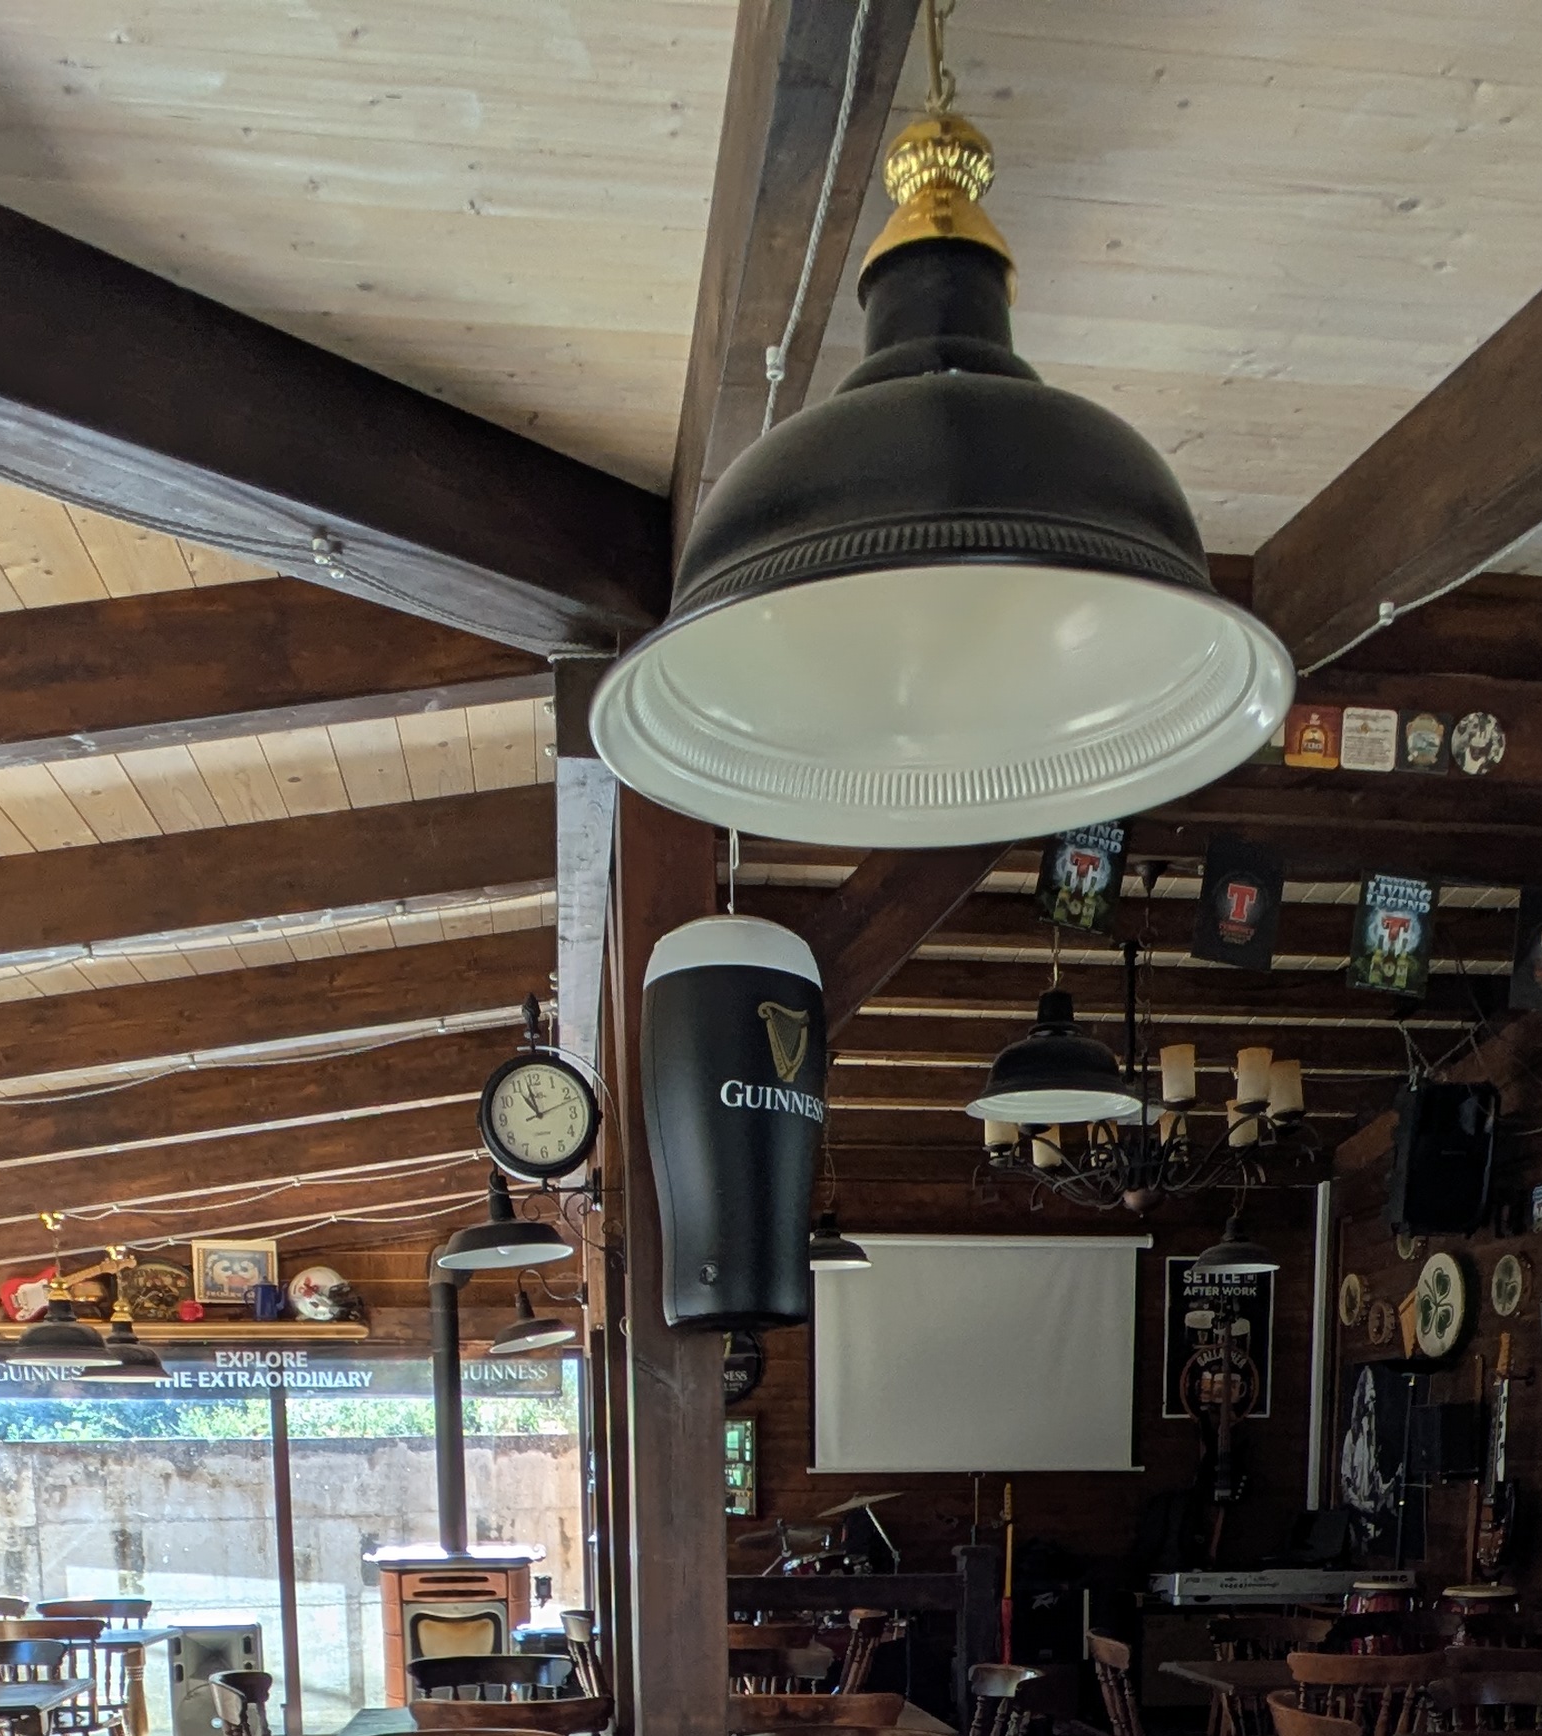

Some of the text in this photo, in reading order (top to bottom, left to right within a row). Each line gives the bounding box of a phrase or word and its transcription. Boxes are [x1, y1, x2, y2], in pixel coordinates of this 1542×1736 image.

[1056, 830, 1122, 853] EGEND
[1367, 881, 1432, 902] LIVING
[1227, 883, 1257, 922] T
[1365, 894, 1430, 913] LEGEND
[720, 1080, 824, 1123] GUINNESS
[1183, 1287, 1257, 1297] AFTER WORK
[215, 1351, 308, 1368] EXPLORE
[198, 1371, 373, 1388] EXTRAORDINARY
